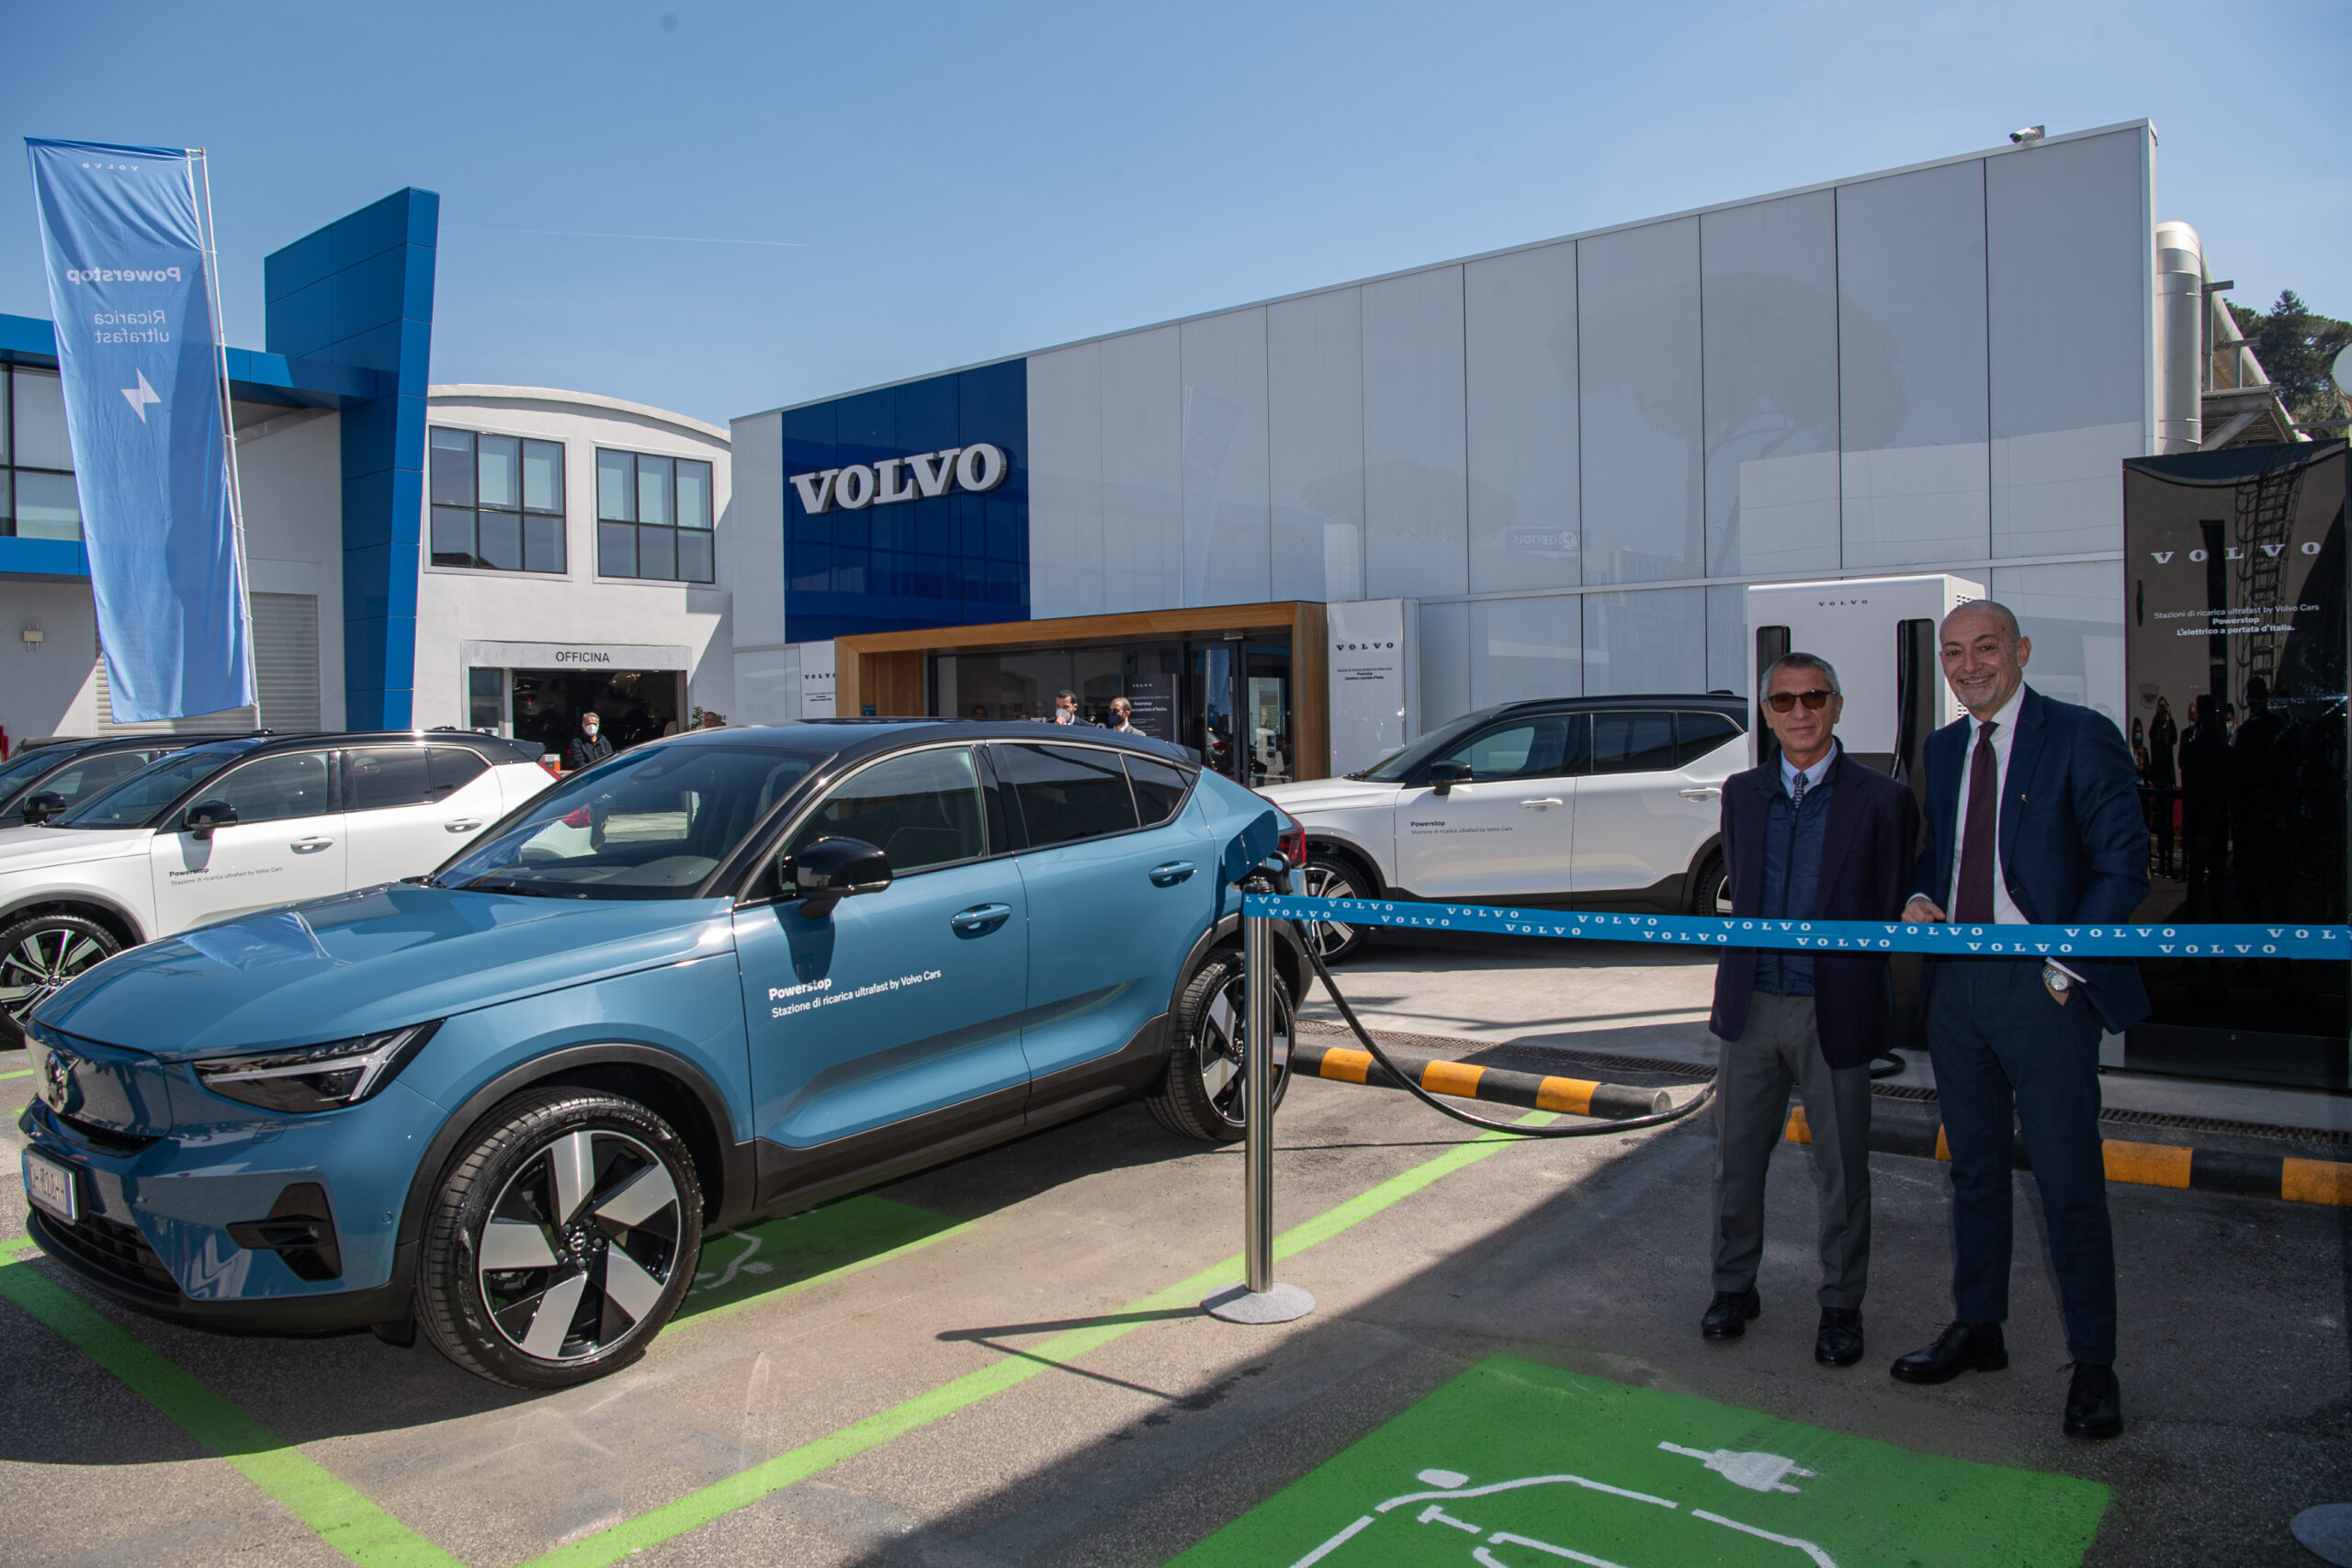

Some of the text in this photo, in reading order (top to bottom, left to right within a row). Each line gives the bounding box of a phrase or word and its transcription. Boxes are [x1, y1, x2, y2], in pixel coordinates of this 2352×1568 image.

[789, 443, 1008, 514] VOLVO
[2150, 541, 2323, 565] VOLVO
[1818, 599, 1869, 607] VOLVO
[2154, 604, 2320, 619] Stazioni di ricarica ultrafast by Volvo Cars
[2212, 616, 2260, 626] Powerstop
[2227, 626, 2260, 635] portata
[1336, 642, 1394, 651] VOLVO
[555, 650, 611, 663] OFFICINA
[169, 867, 209, 877] Powerstop
[1329, 900, 1394, 911] VOLVO
[1446, 907, 1520, 919] VOLVO
[1577, 915, 1657, 926] VOLVO
[1722, 920, 1812, 931] VOLVO
[1883, 924, 1984, 936] VOLVO
[2064, 928, 2176, 938] VOLVO
[1268, 908, 2277, 954] VOLVO VOLVO VOLVO VOLVO VOLVO VOLVO VOLVO
[768, 977, 832, 1001] Powerstop
[772, 969, 942, 1019] Stazione di ricarica ultrafast by Volvo Cars
